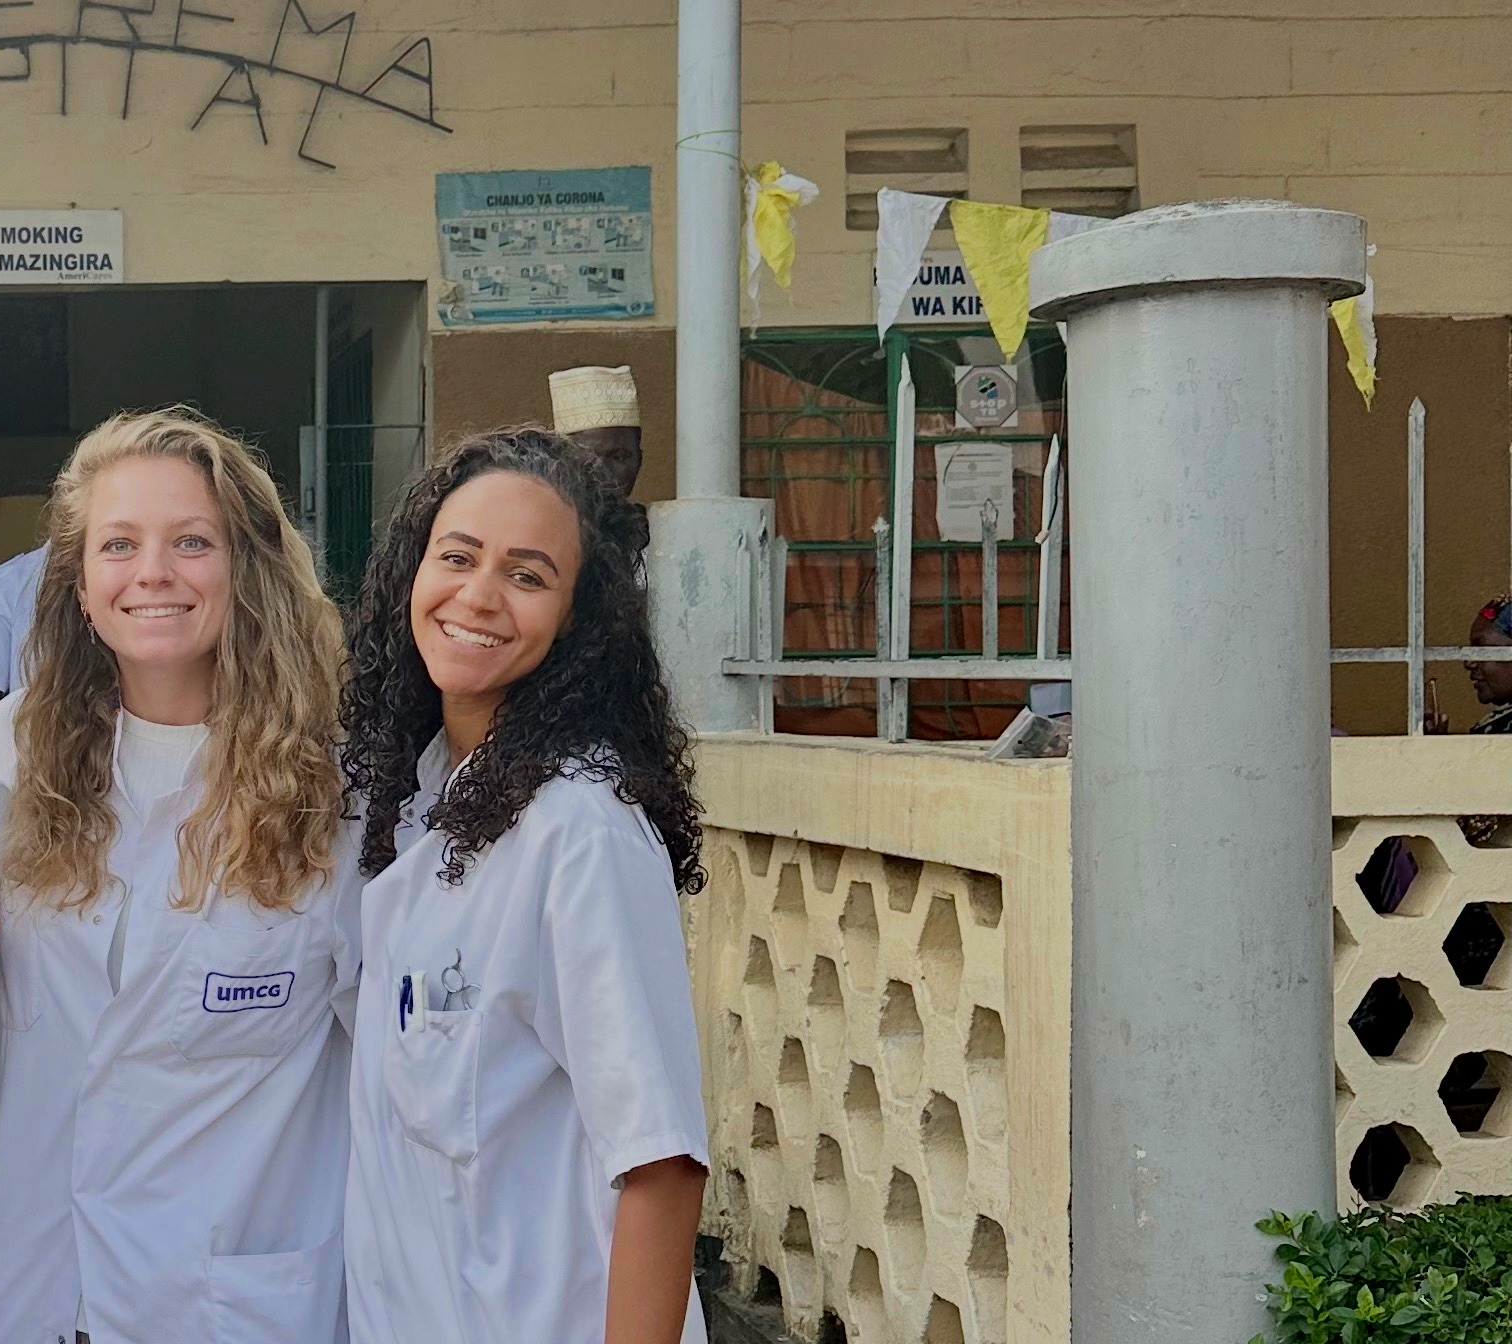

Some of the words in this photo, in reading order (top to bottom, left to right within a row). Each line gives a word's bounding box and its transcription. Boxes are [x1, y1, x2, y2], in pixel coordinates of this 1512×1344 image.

[487, 194, 534, 206] CHANJO
[537, 193, 552, 205] YA
[556, 191, 605, 204] CORONA
[912, 296, 945, 316] WA
